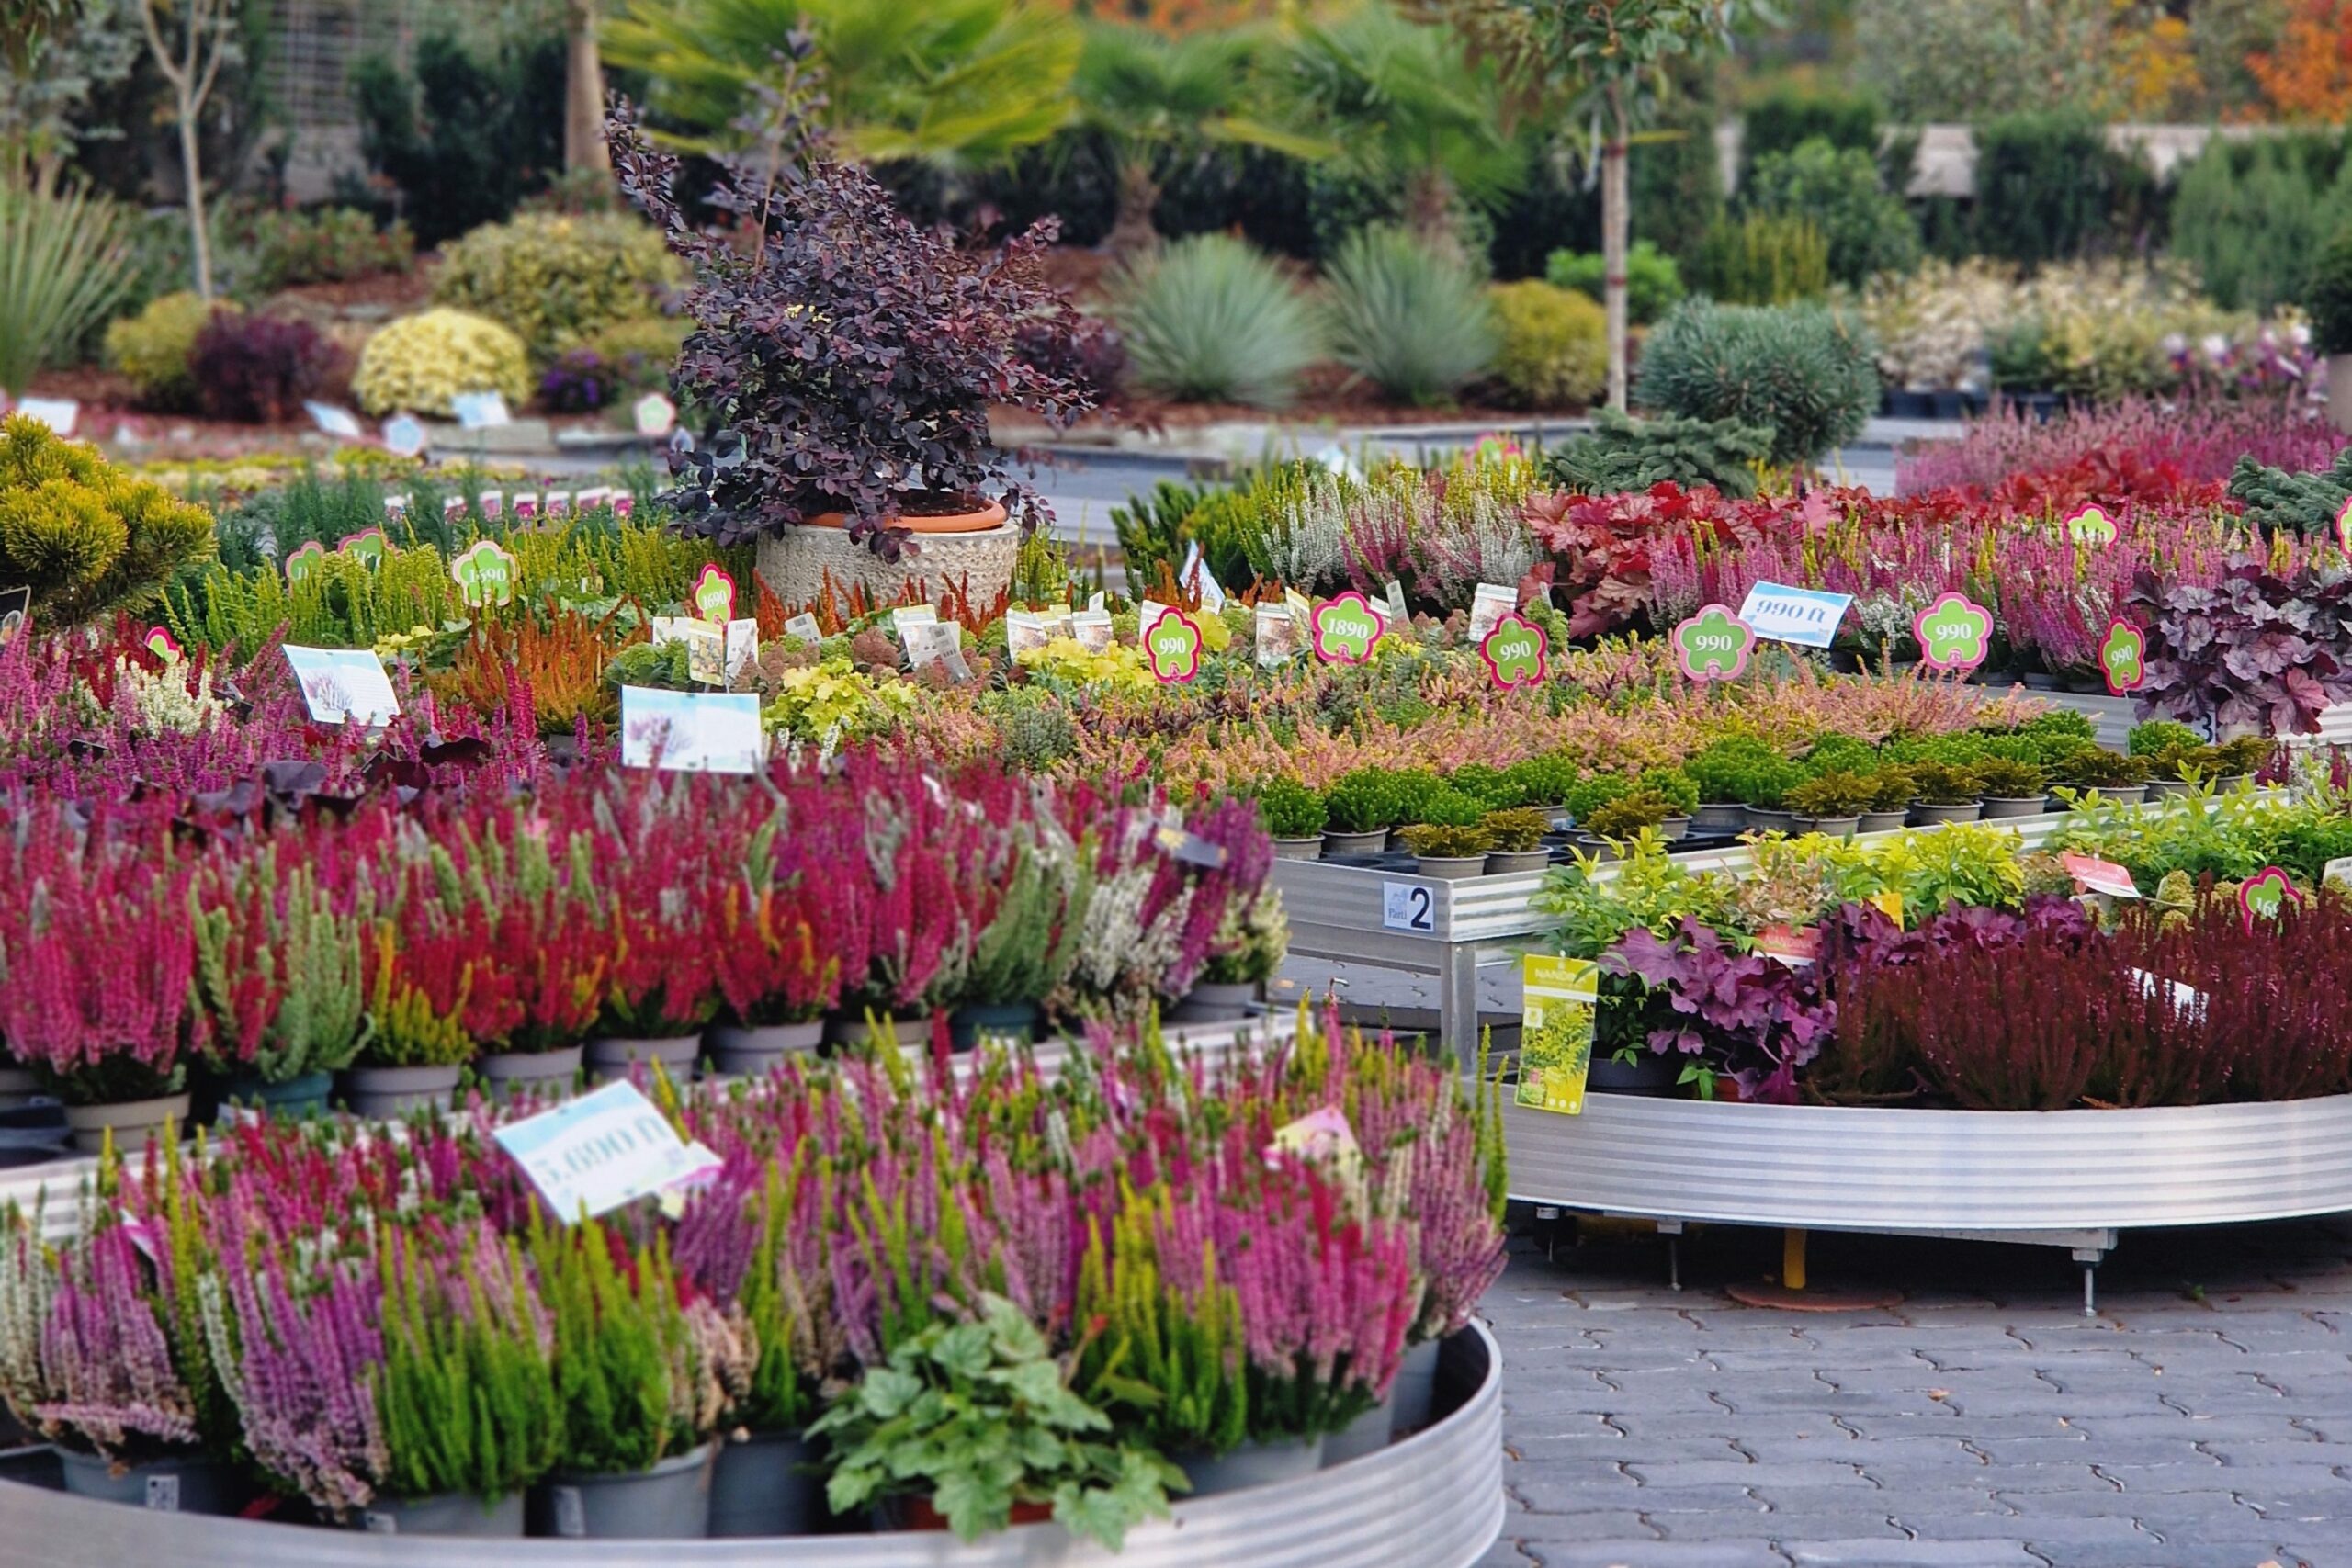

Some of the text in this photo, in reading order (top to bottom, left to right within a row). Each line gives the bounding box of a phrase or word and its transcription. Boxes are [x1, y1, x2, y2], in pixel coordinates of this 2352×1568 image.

[702, 590, 726, 610] 1690
[1756, 599, 1804, 619] 990
[1329, 617, 1368, 639] 1890
[1936, 623, 1972, 641] 990
[1159, 637, 1185, 655] 990
[1499, 640, 1531, 661] 990
[1695, 635, 1732, 651] 990
[2111, 644, 2132, 668] 990
[1410, 887, 1431, 930] 2
